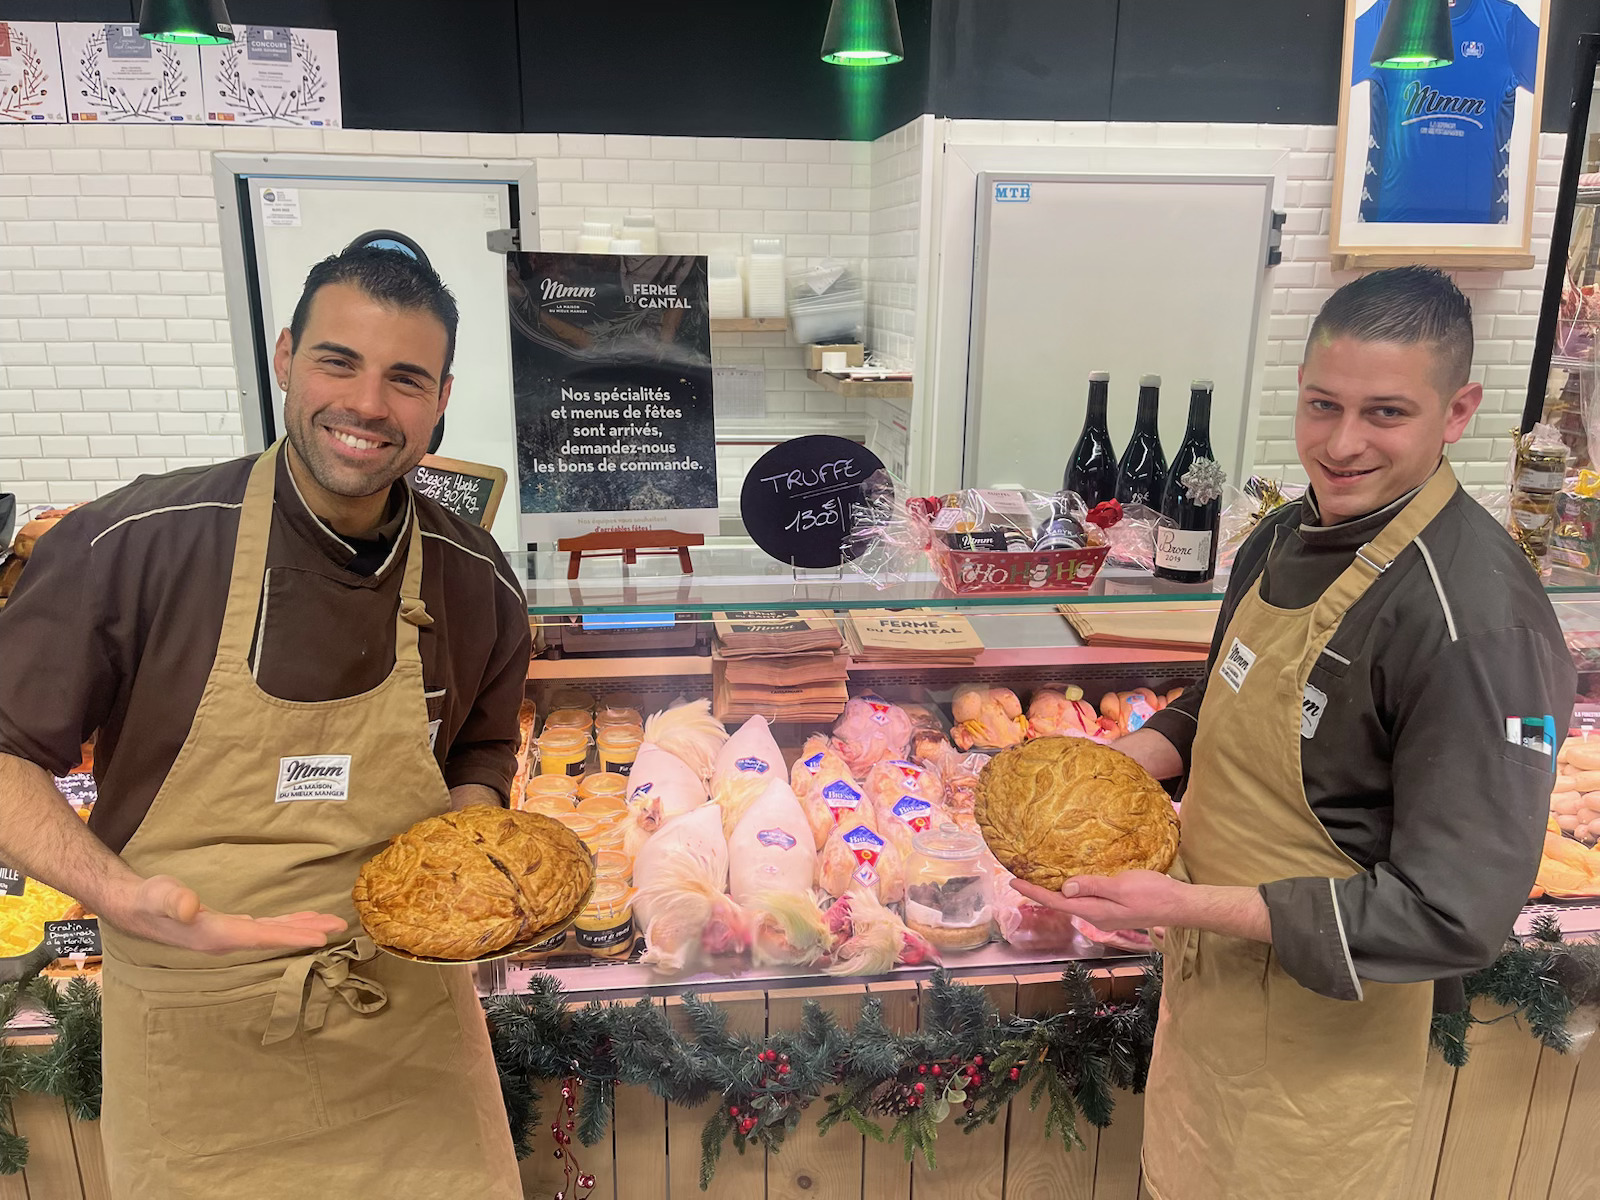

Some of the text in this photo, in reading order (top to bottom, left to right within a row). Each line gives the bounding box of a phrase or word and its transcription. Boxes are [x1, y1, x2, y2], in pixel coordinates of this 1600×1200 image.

[1404, 80, 1485, 115] Mmm
[995, 187, 1031, 198] MTH
[540, 278, 596, 300] Mmm
[633, 284, 677, 295] FERME
[638, 297, 691, 309] CANTAL
[561, 386, 671, 404] Nos spécialités
[551, 404, 682, 419] et menus de fêtes
[573, 422, 663, 438] sont arrivés,
[560, 440, 676, 455] demandez-nous
[533, 456, 703, 473] les bons de commande.
[414, 467, 452, 491] Steack
[760, 458, 861, 493] TRUFFE
[1165, 554, 1181, 562] 2019
[879, 620, 940, 628] FERME
[287, 761, 343, 781] Mmm
[0, 867, 19, 881] ILLE
[49, 922, 82, 931] Gratin
